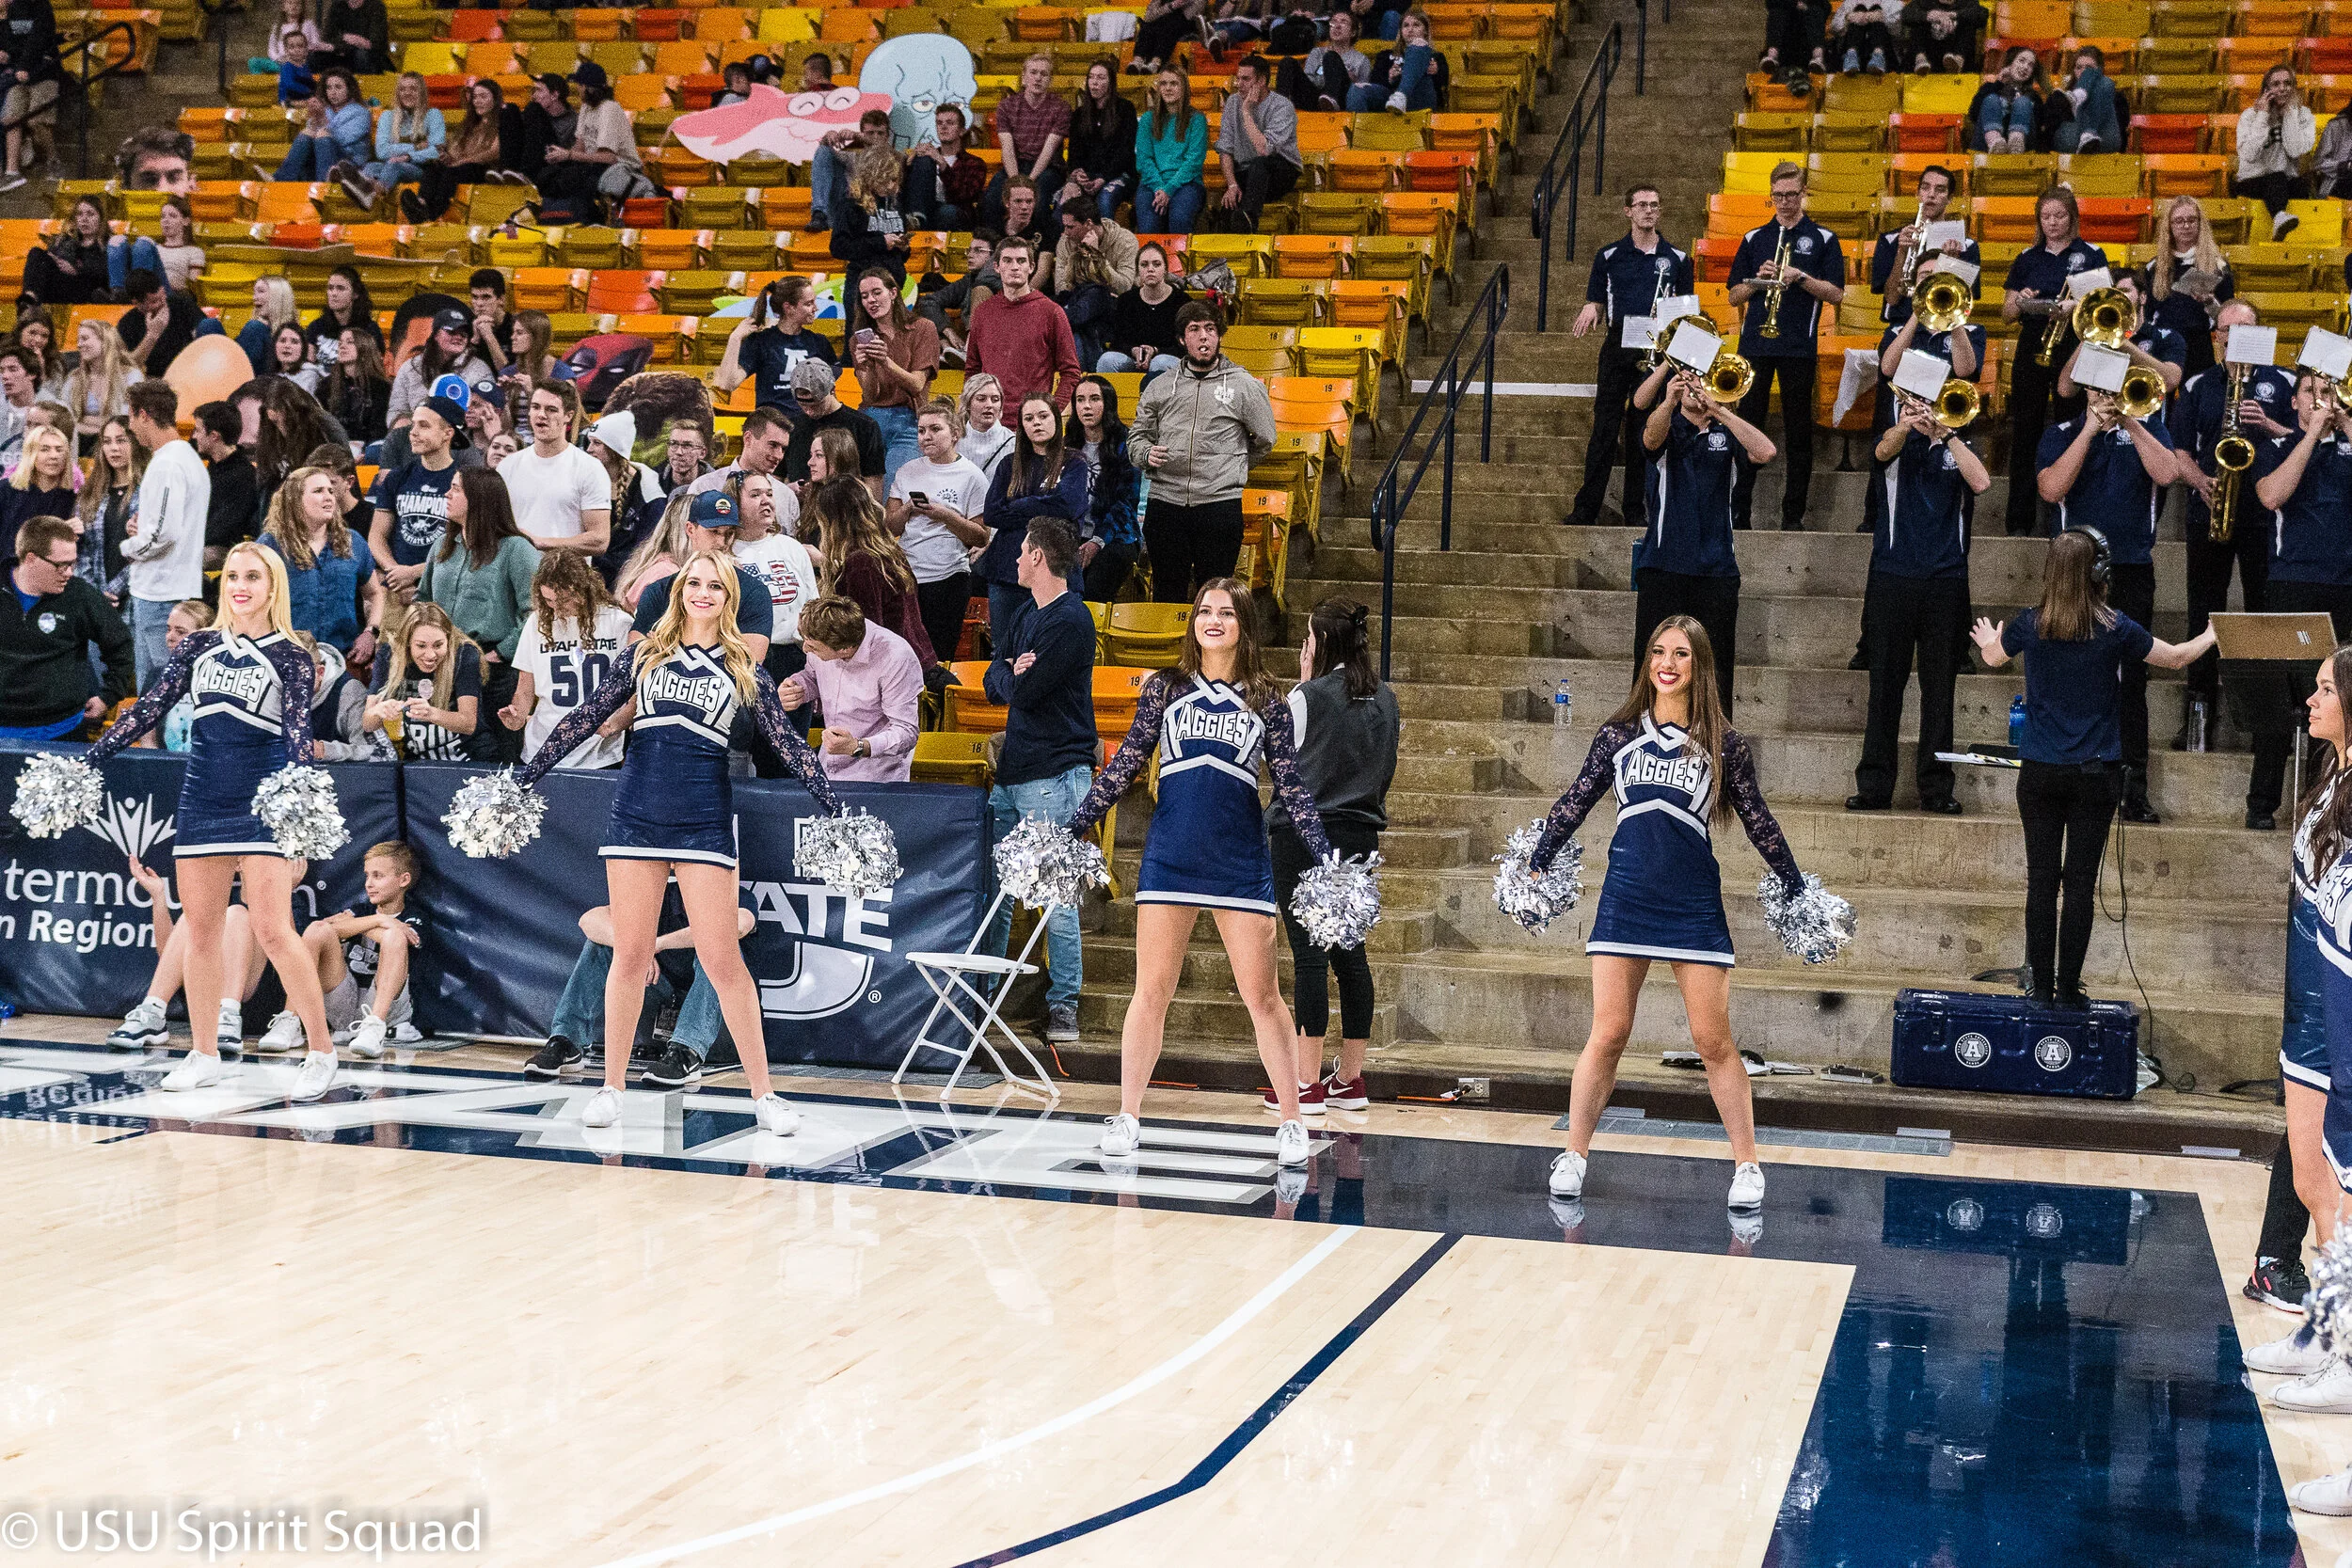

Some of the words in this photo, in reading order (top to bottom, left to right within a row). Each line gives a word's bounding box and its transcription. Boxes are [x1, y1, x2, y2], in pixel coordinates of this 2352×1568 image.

[1715, 288, 1721, 296] 9
[1353, 334, 1362, 342] 19
[1324, 384, 1333, 392] 19
[1292, 438, 1301, 447] 19
[1257, 497, 1267, 506] 19
[1177, 611, 1187, 622] 19
[195, 656, 266, 703] AGGIES
[550, 653, 611, 707] 50
[1130, 676, 1140, 687] 19
[646, 665, 723, 713] AGGIES
[1175, 701, 1250, 749] AGGIES
[972, 743, 982, 753] 18
[1624, 747, 1703, 794] AGGIES
[27, 909, 157, 953] Region
[1964, 1040, 1982, 1058] A
[2043, 1044, 2061, 1061] A
